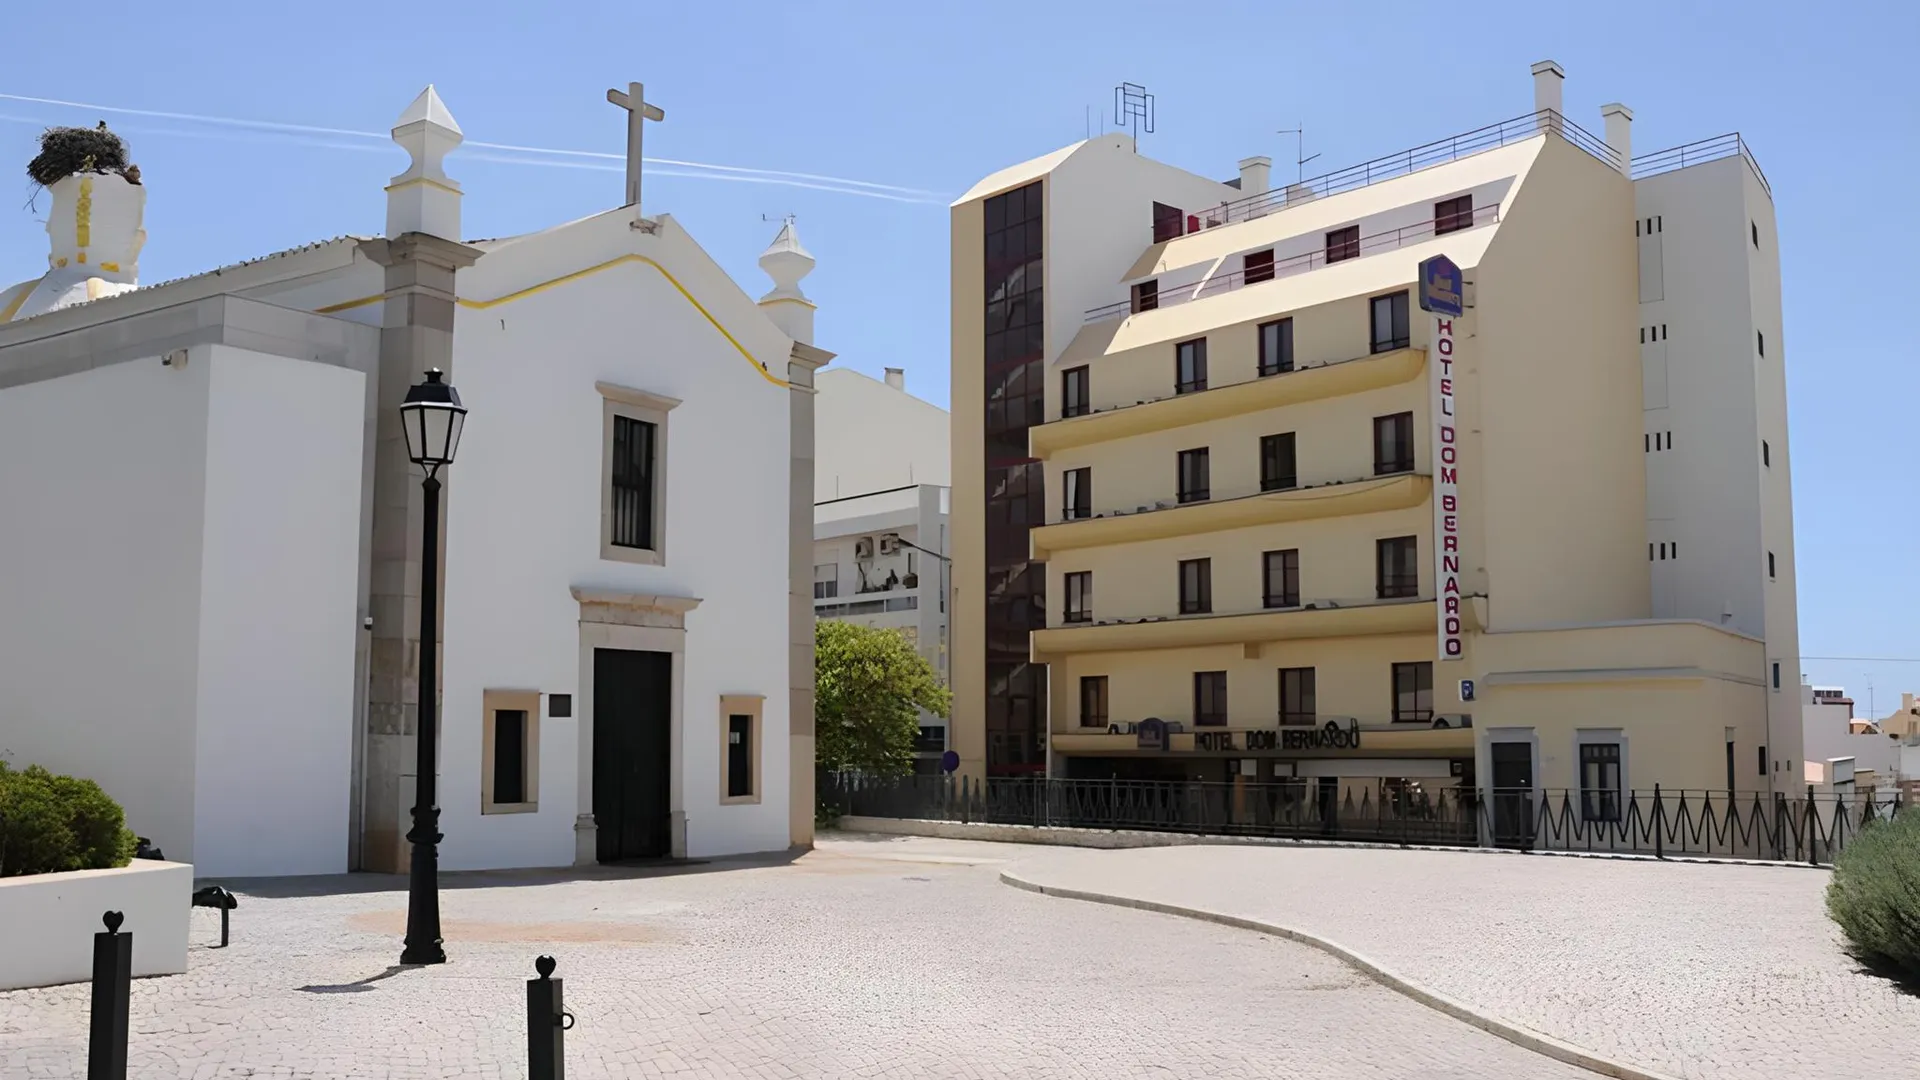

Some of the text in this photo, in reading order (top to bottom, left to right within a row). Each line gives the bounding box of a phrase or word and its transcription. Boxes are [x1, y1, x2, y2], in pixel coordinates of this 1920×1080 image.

[1438, 318, 1453, 416] HOTEL
[1441, 426, 1457, 484] DOM
[1442, 495, 1461, 655] BERNARDO
[1195, 731, 1238, 750] HOTEL
